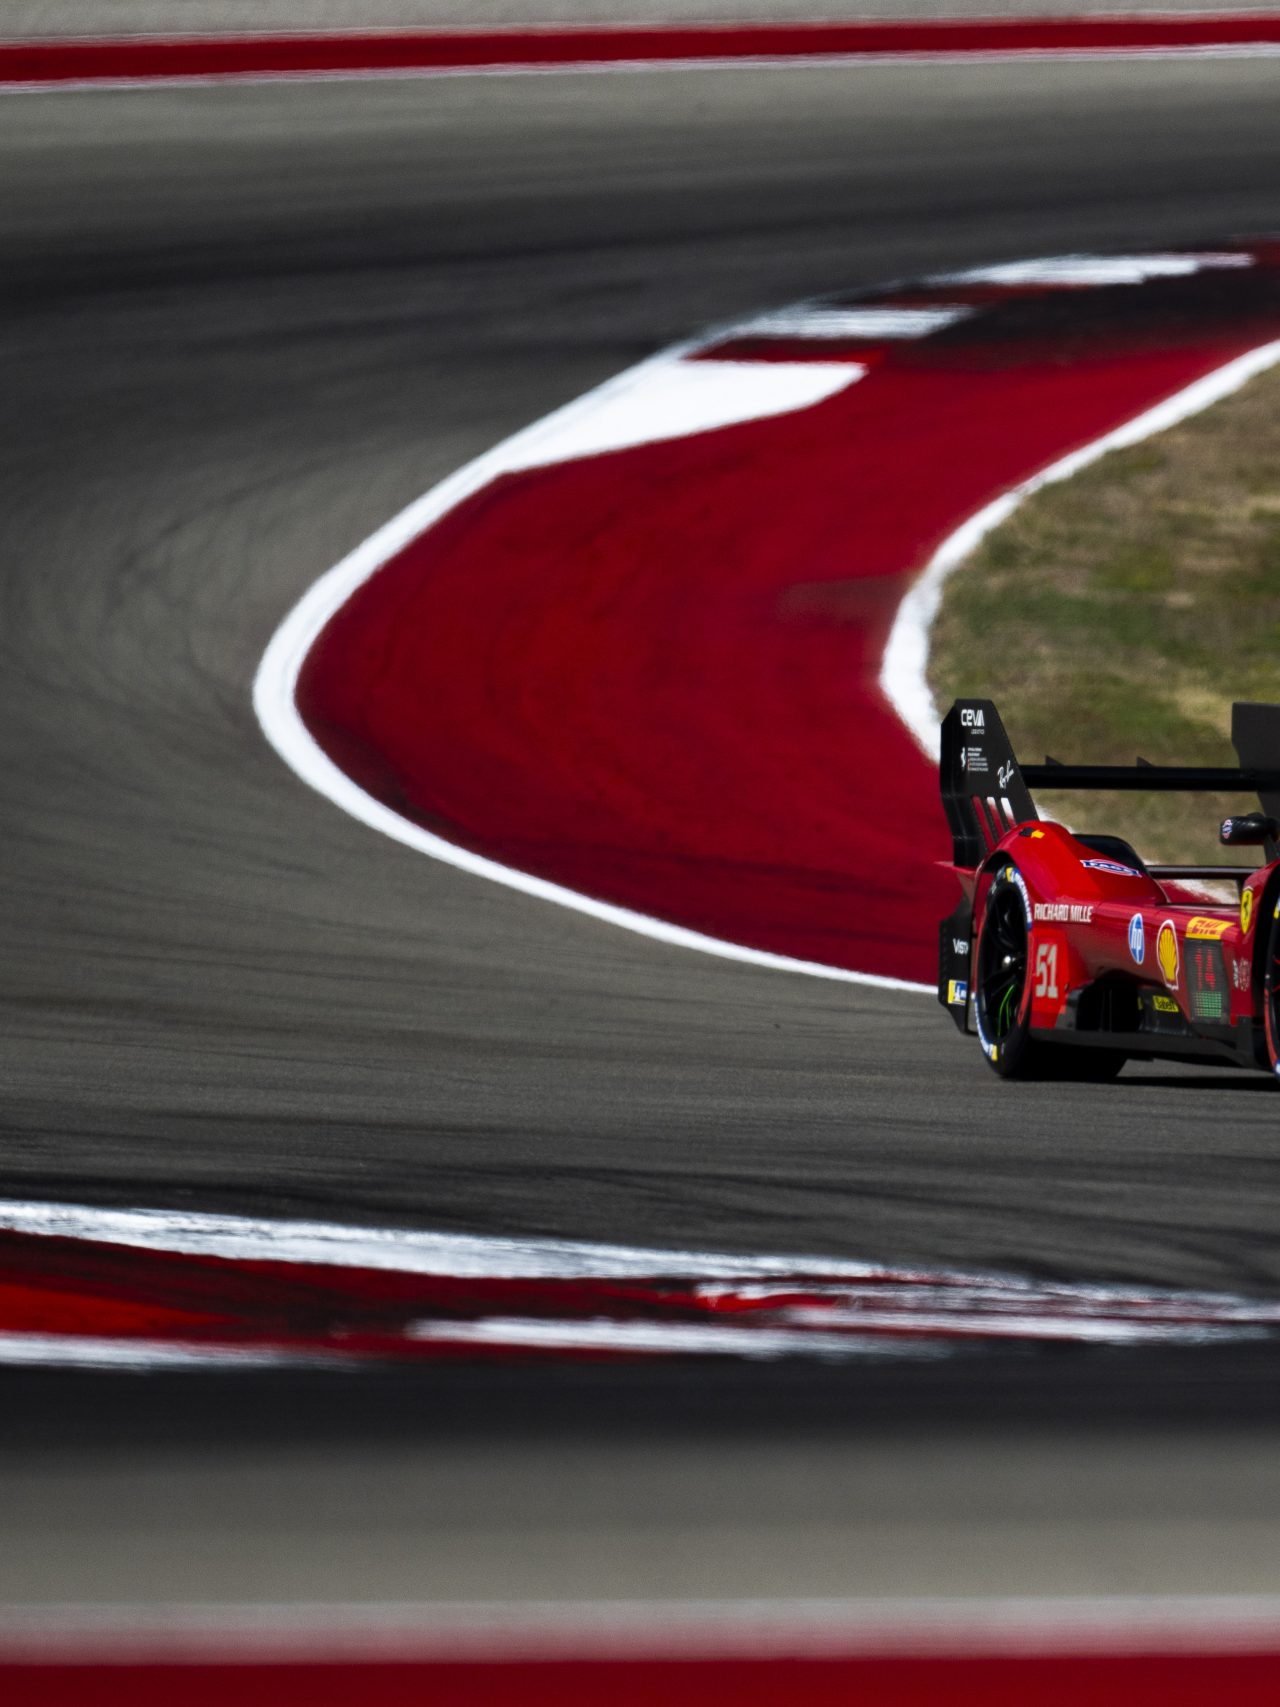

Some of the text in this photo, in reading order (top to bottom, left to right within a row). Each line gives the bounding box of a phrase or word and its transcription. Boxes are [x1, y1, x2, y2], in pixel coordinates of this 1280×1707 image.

[1034, 903, 1094, 923] RICHARD MILLE
[1035, 943, 1059, 999] 51
